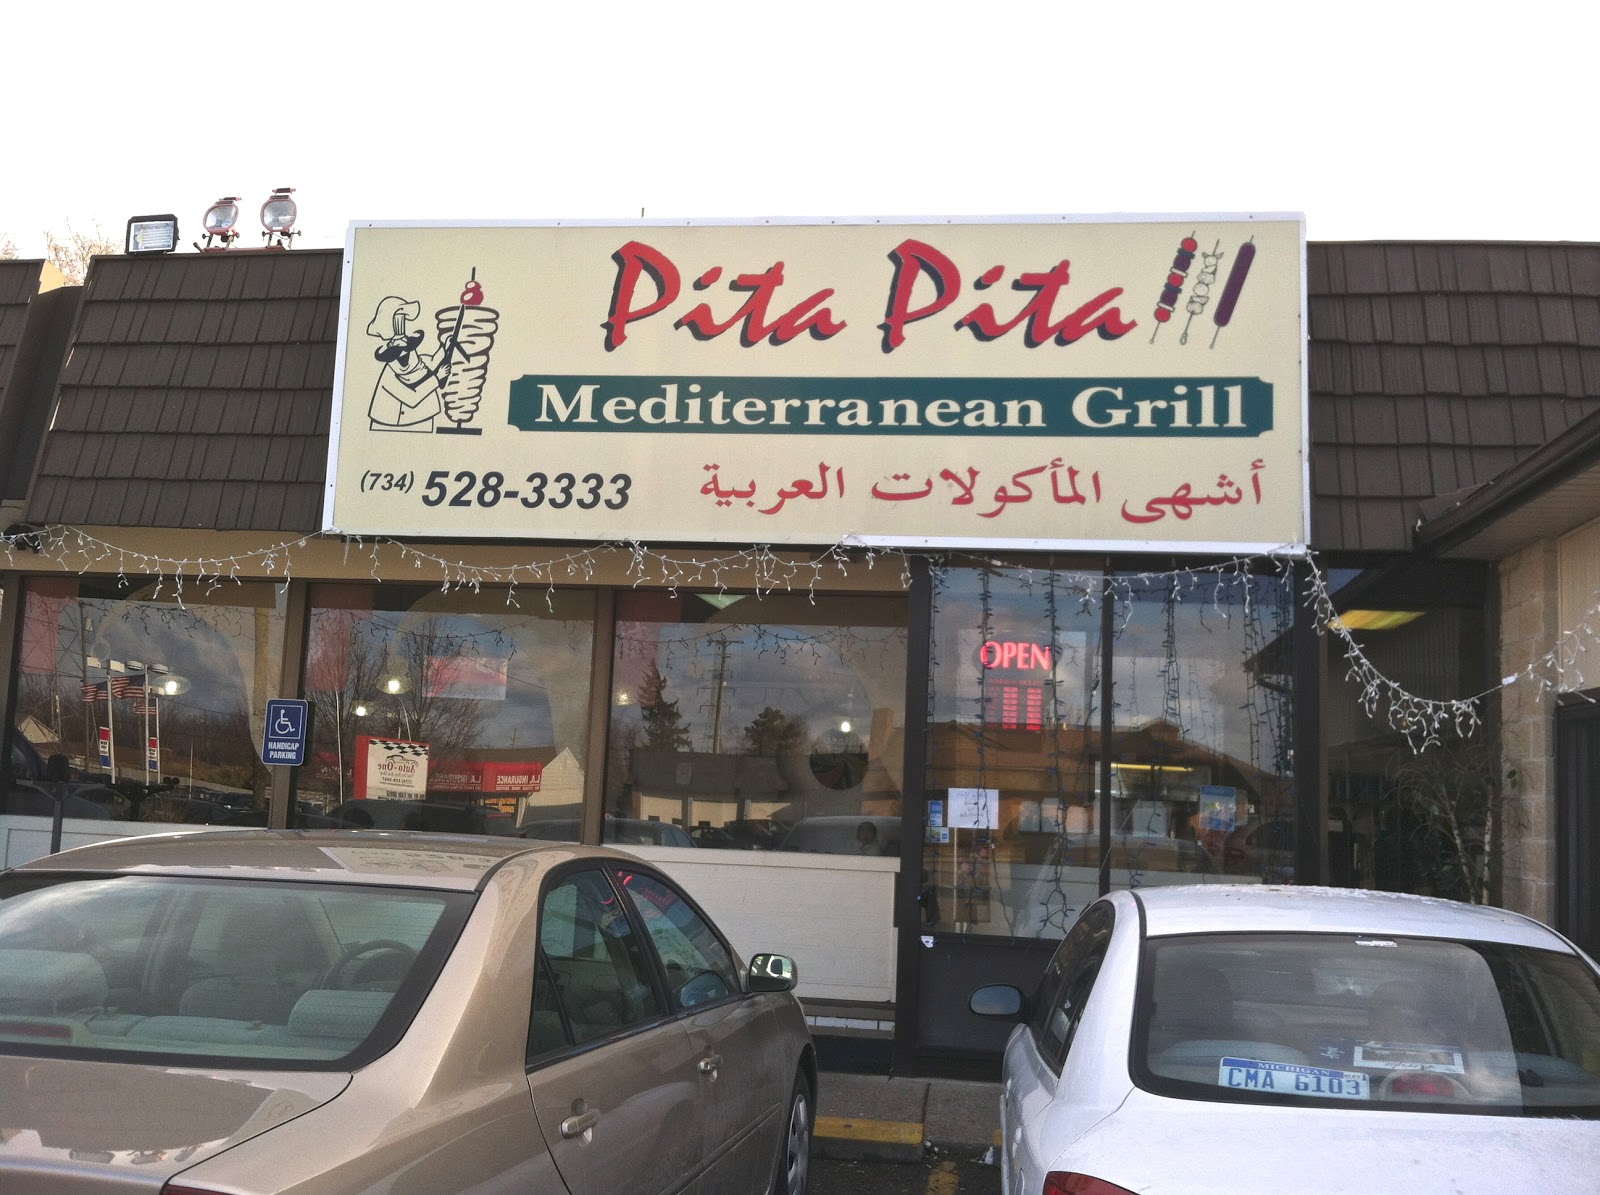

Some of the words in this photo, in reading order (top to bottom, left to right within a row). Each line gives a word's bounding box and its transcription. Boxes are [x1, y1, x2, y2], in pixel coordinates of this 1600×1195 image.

[600, 240, 847, 353] Pita
[876, 239, 1137, 354] Pita
[535, 383, 1046, 427] Mediterranean
[1072, 385, 1246, 428] Grill
[360, 470, 415, 494] (734)
[421, 470, 632, 511] 528-3333
[699, 462, 845, 515] العربية
[979, 640, 1051, 670] OPEN
[268, 741, 300, 750] HANDICAP
[269, 751, 297, 759] PARKING
[1228, 1067, 1275, 1090] CMA
[1294, 1073, 1361, 1096] 6103
[1257, 1062, 1330, 1076] MICHIGAN
